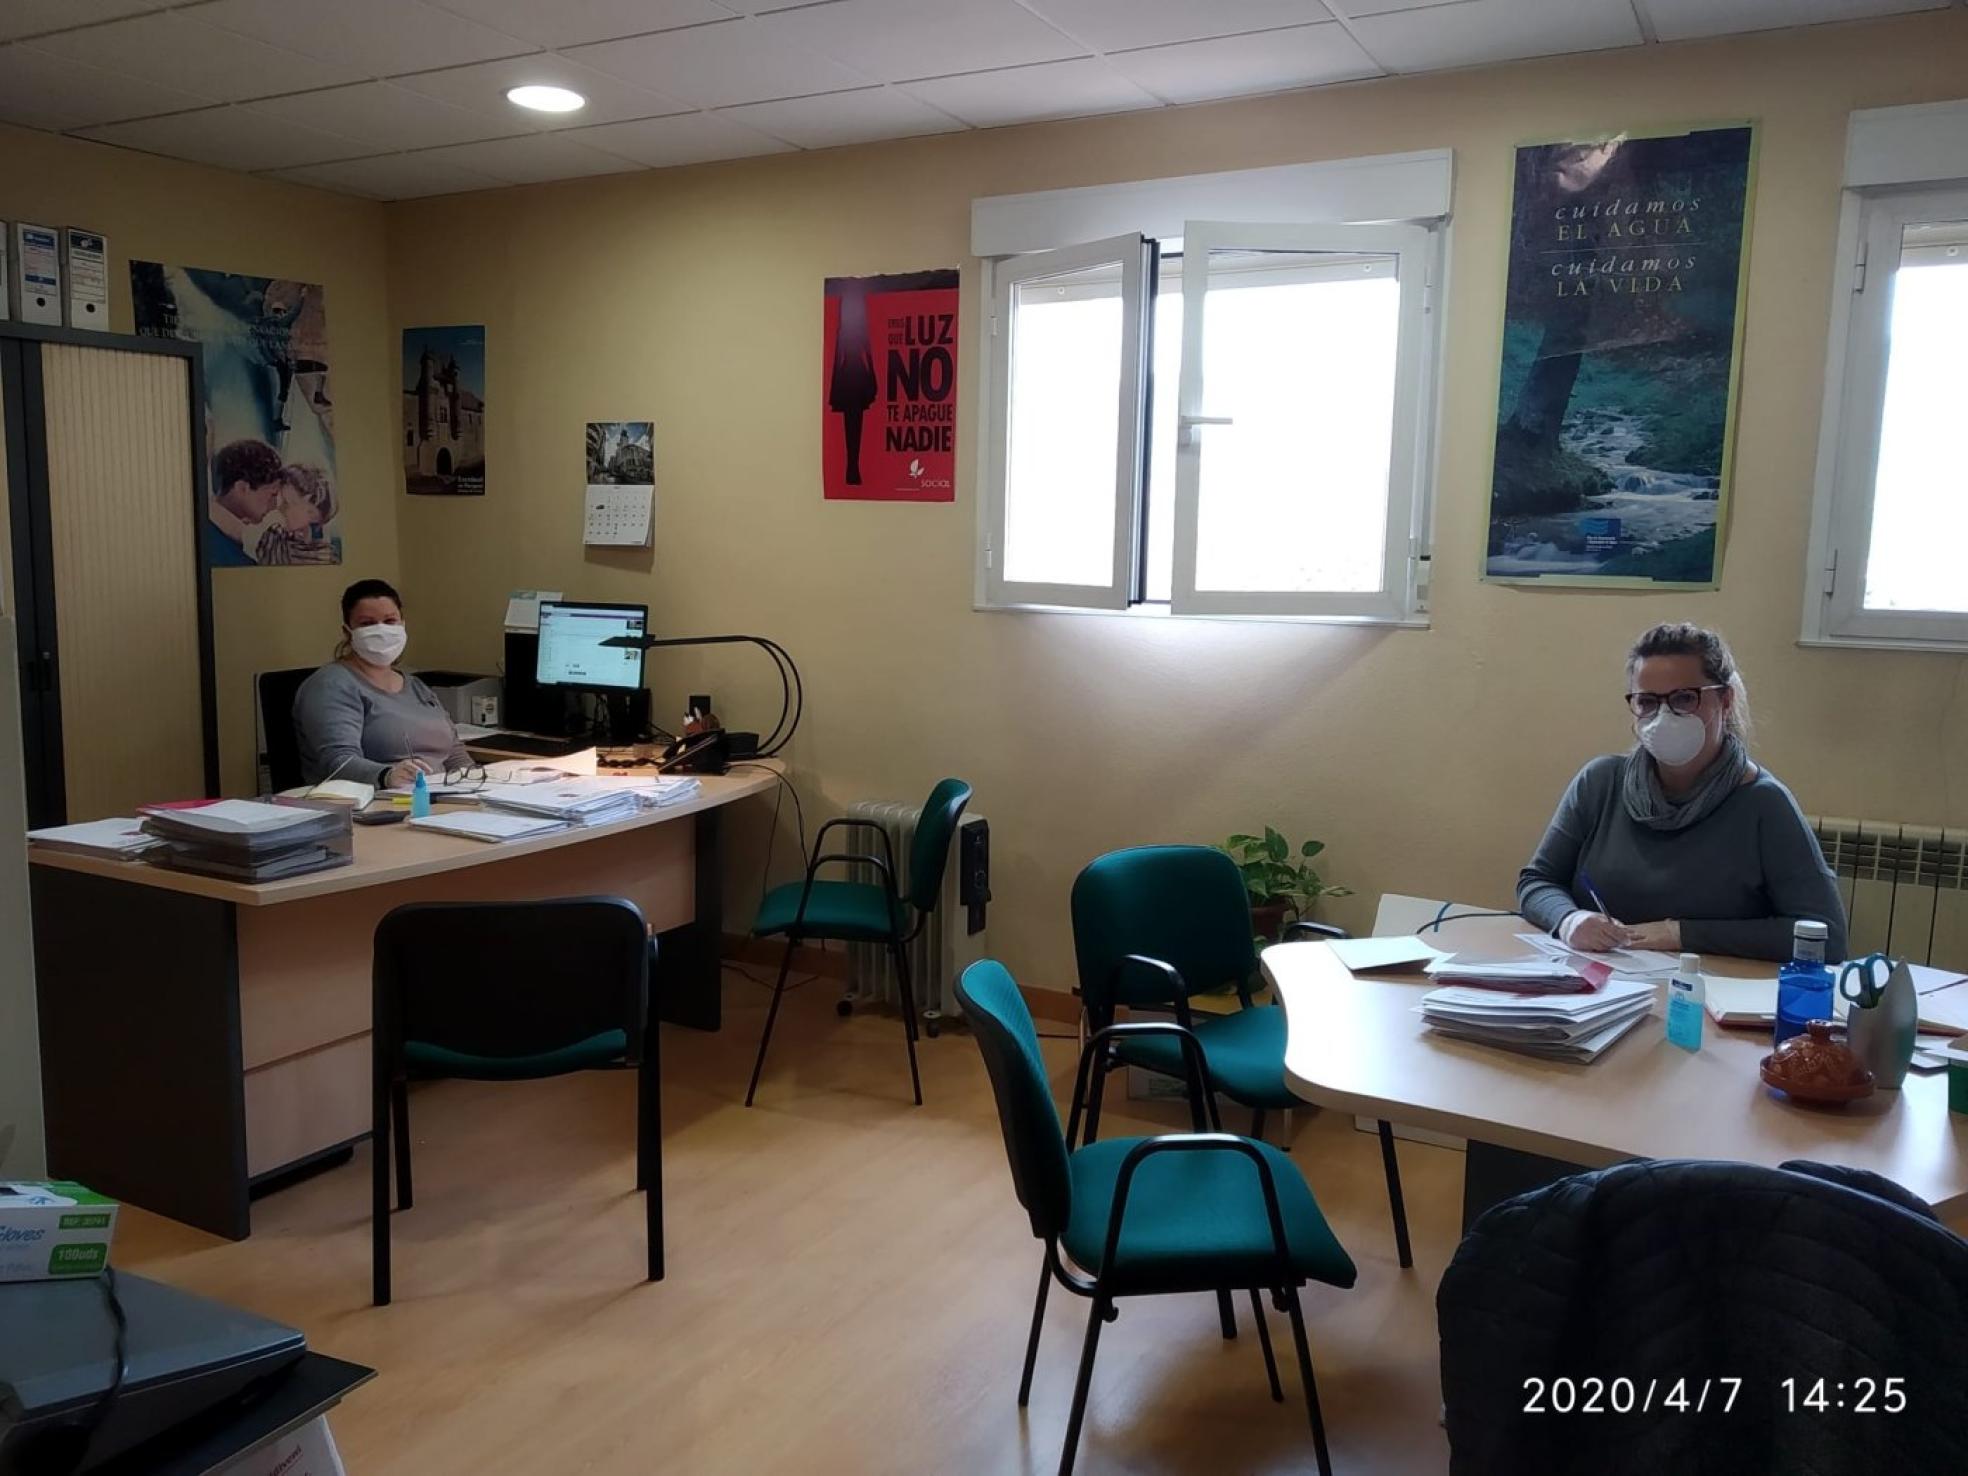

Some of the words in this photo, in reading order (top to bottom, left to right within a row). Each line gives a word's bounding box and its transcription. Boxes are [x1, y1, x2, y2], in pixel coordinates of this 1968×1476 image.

[1555, 199, 1701, 220] cuidamos
[1556, 224, 1587, 241] EL
[1607, 217, 1692, 238] AGUA
[1551, 255, 1696, 277] cuidamos
[1556, 280, 1589, 297] LA
[1609, 275, 1683, 294] VIDA
[905, 314, 954, 345] LUZ
[886, 346, 954, 402] NO
[887, 403, 899, 422] TE
[903, 403, 953, 422] APAGUE
[885, 426, 953, 452] NADIE
